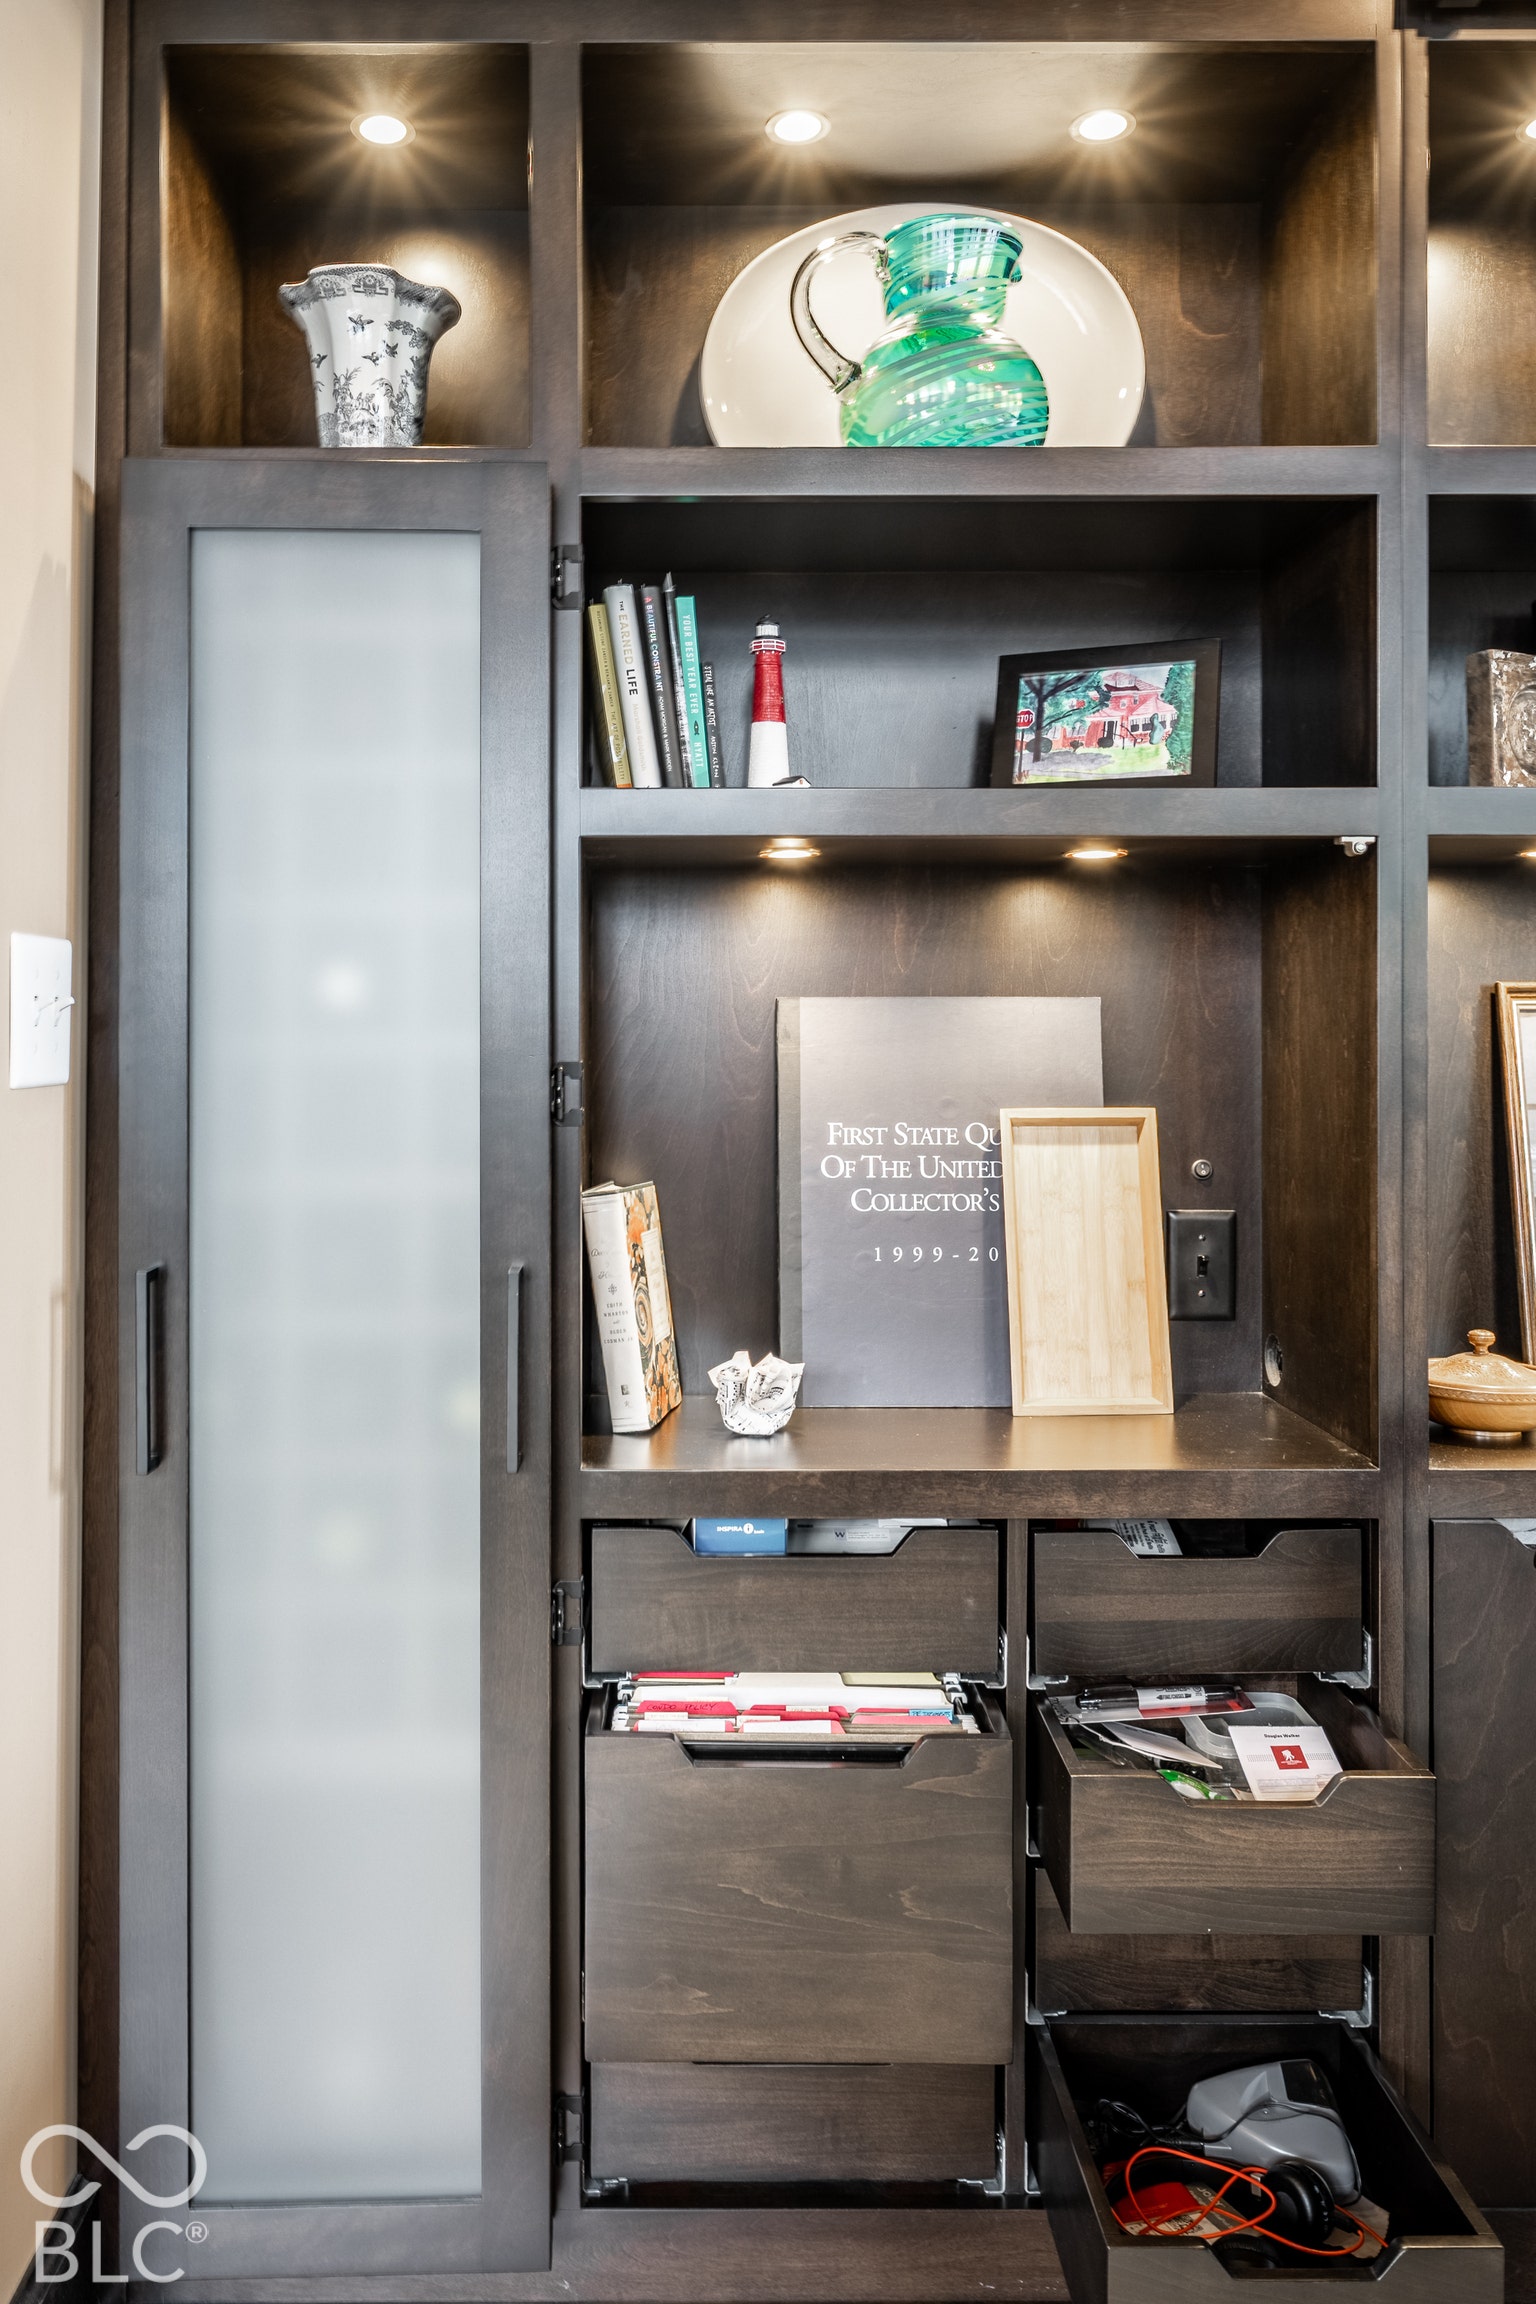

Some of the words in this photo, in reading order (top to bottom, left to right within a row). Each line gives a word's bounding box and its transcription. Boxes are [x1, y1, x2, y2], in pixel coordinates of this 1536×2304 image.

[644, 595, 653, 604] A
[646, 605, 657, 643] BEAUTIFUL
[683, 615, 692, 637] YOUR
[619, 614, 634, 665] EARNED
[685, 641, 695, 662] BEST
[651, 644, 664, 692] CONSTRAINT
[687, 667, 696, 689] YEAR
[626, 669, 638, 696] LIFE
[689, 693, 699, 714] EVER
[694, 742, 704, 767] HYATT
[827, 1122, 888, 1146] FIRST
[894, 1122, 960, 1146] STATE
[820, 1155, 856, 1179] OF
[860, 1155, 912, 1179] THE
[917, 1155, 1003, 1179] UNITED
[850, 1187, 1000, 1212] COLLECTOR'S
